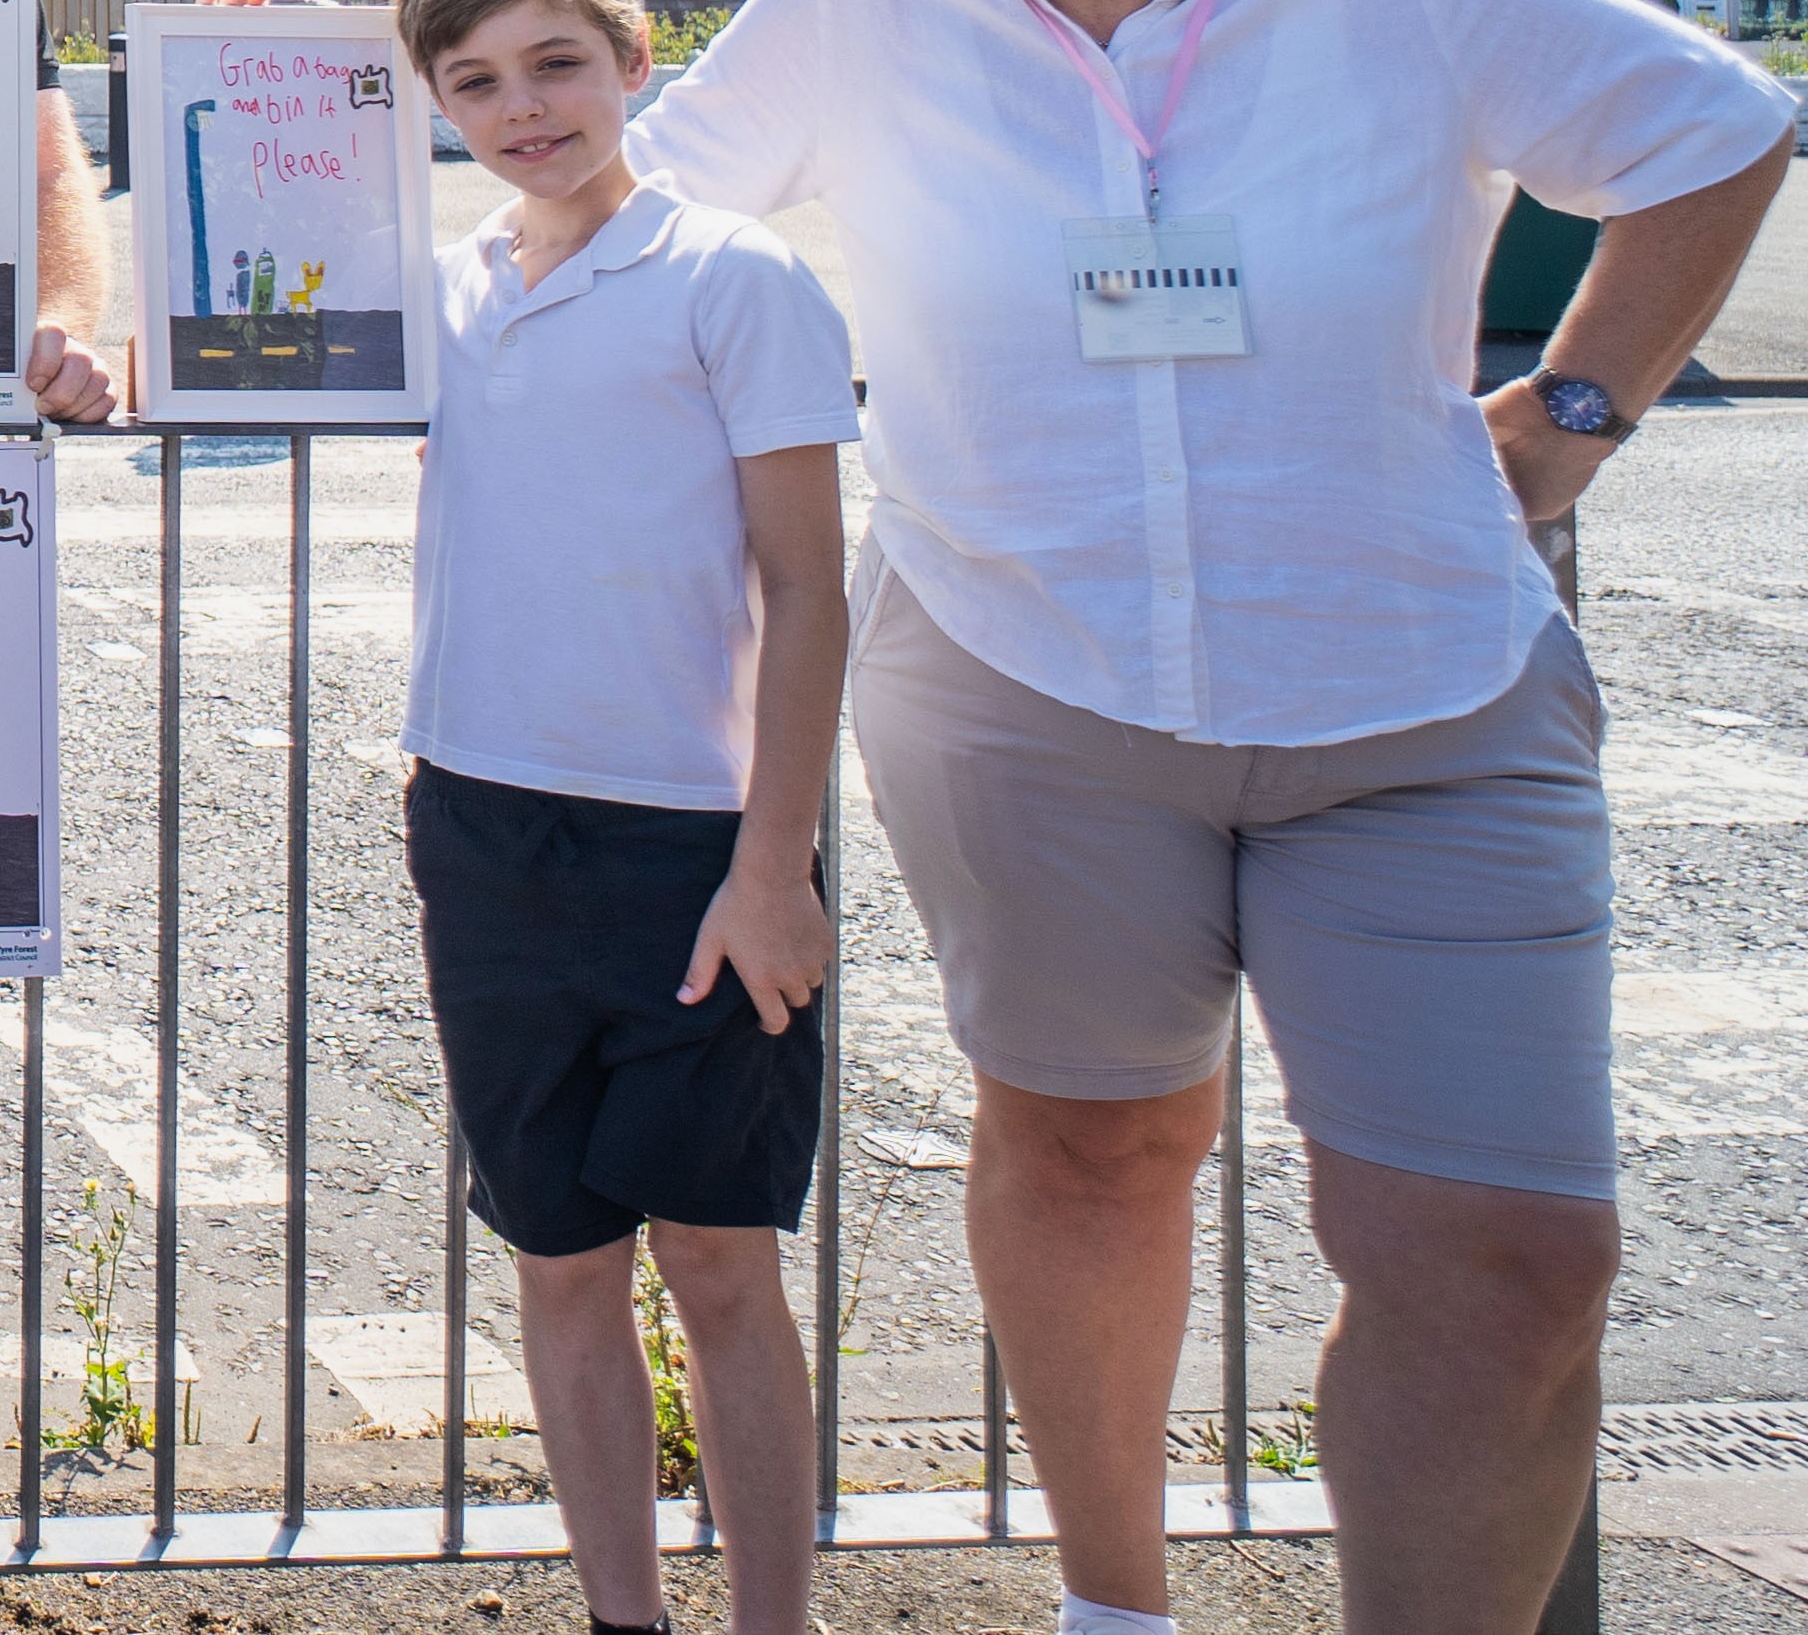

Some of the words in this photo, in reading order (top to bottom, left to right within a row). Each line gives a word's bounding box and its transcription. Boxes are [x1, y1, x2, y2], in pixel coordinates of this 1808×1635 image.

[218, 42, 284, 87] Grab
[231, 97, 261, 116] and
[267, 94, 305, 125] bin
[318, 94, 337, 119] it
[13, 945, 38, 954] Forest
